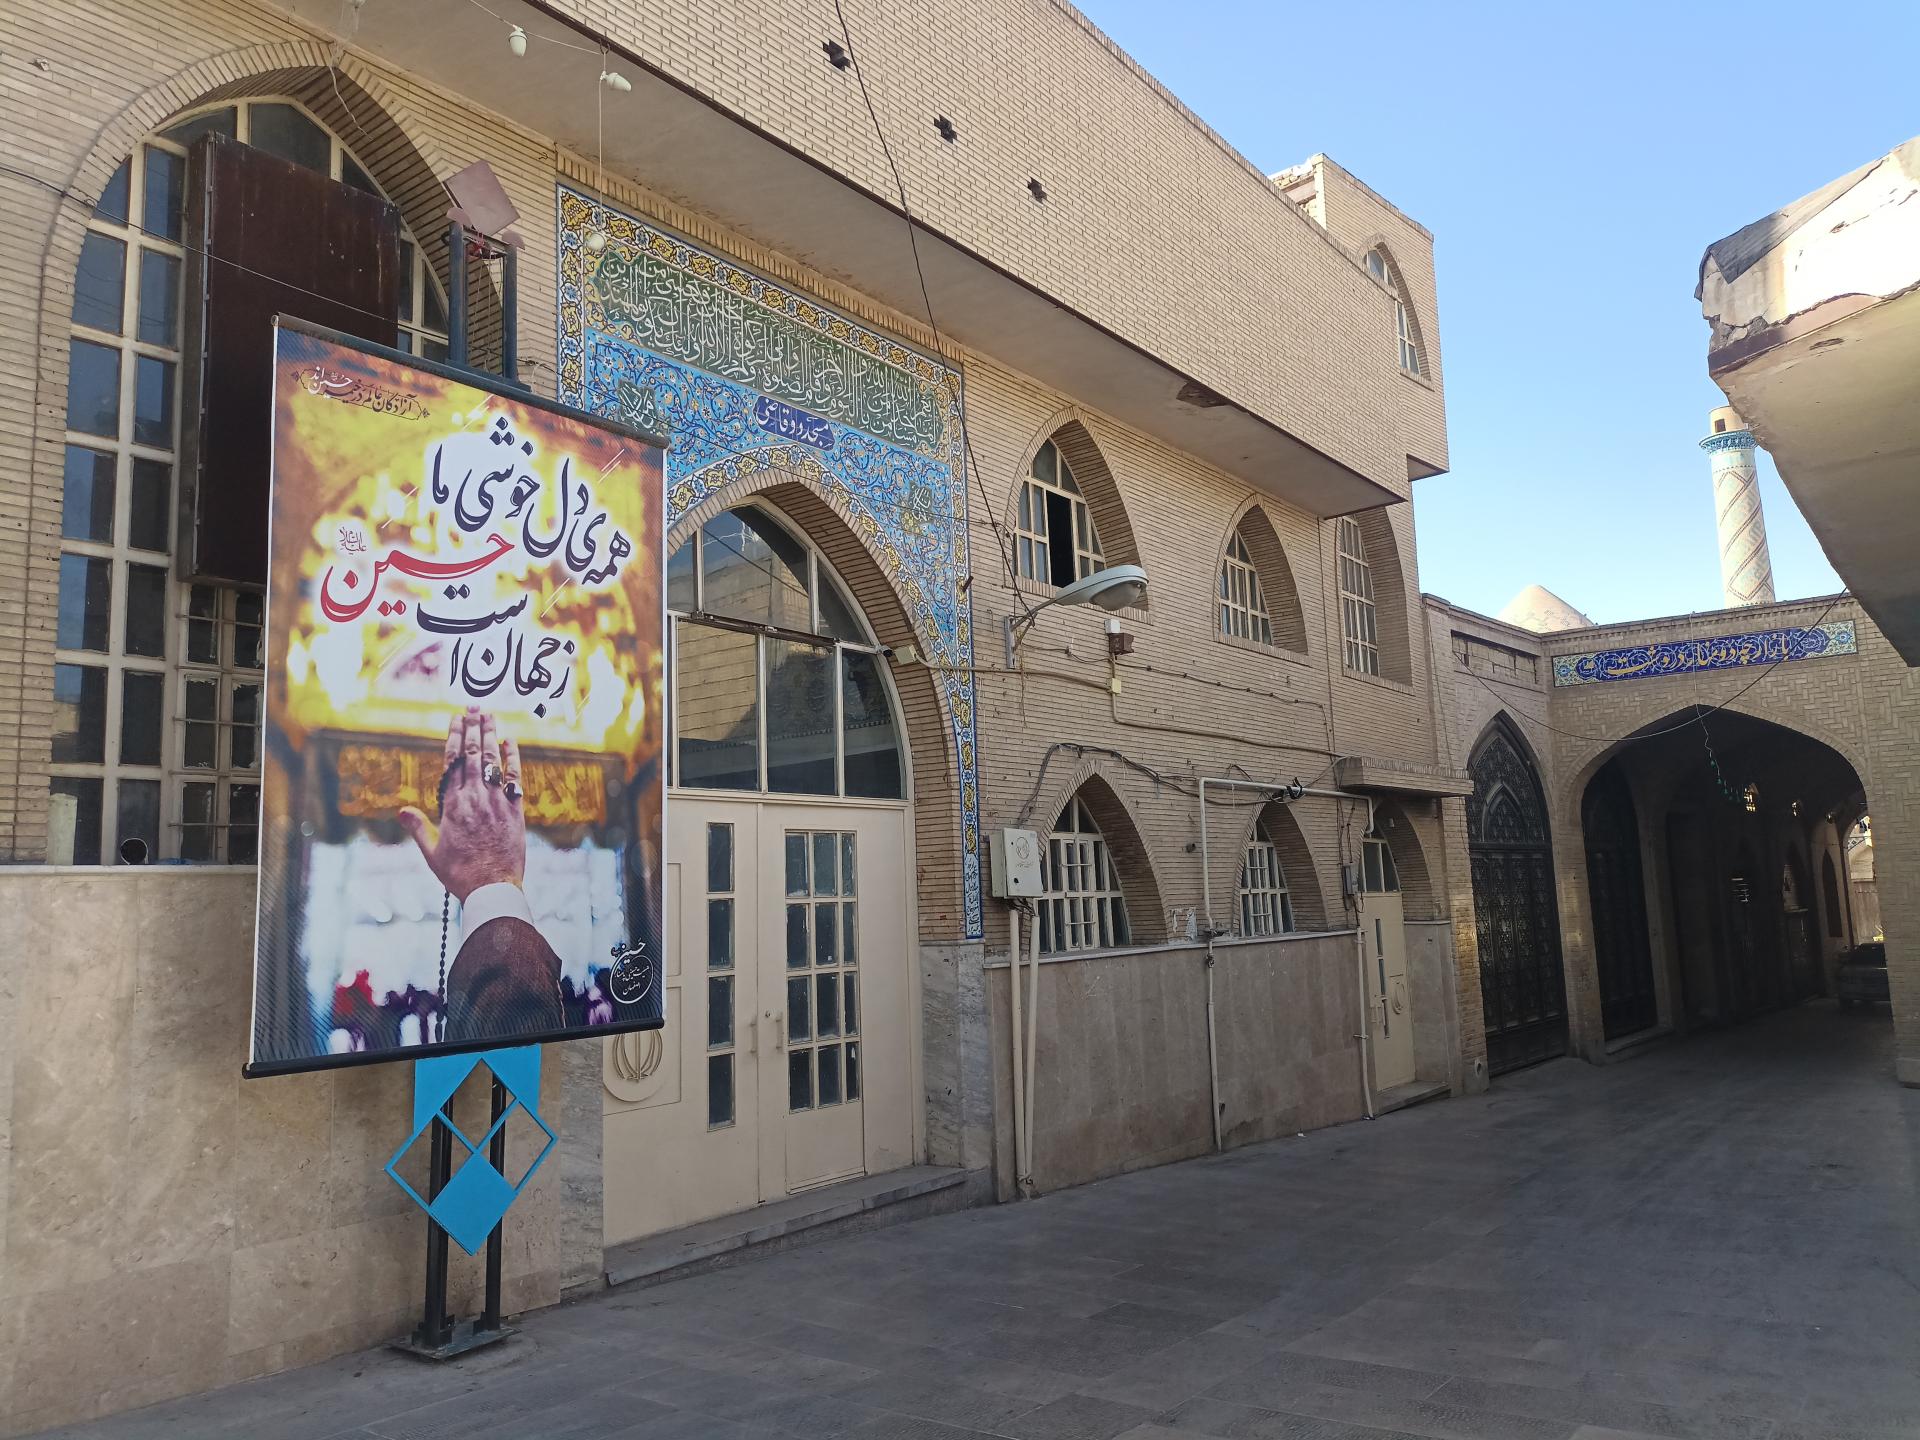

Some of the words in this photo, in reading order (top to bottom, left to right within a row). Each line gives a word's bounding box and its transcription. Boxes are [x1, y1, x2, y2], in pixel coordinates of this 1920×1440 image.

[800, 415, 830, 447] مسجد
[432, 443, 450, 505] ما
[320, 532, 516, 623] حسین
[1740, 632, 1790, 665] بازارچه
